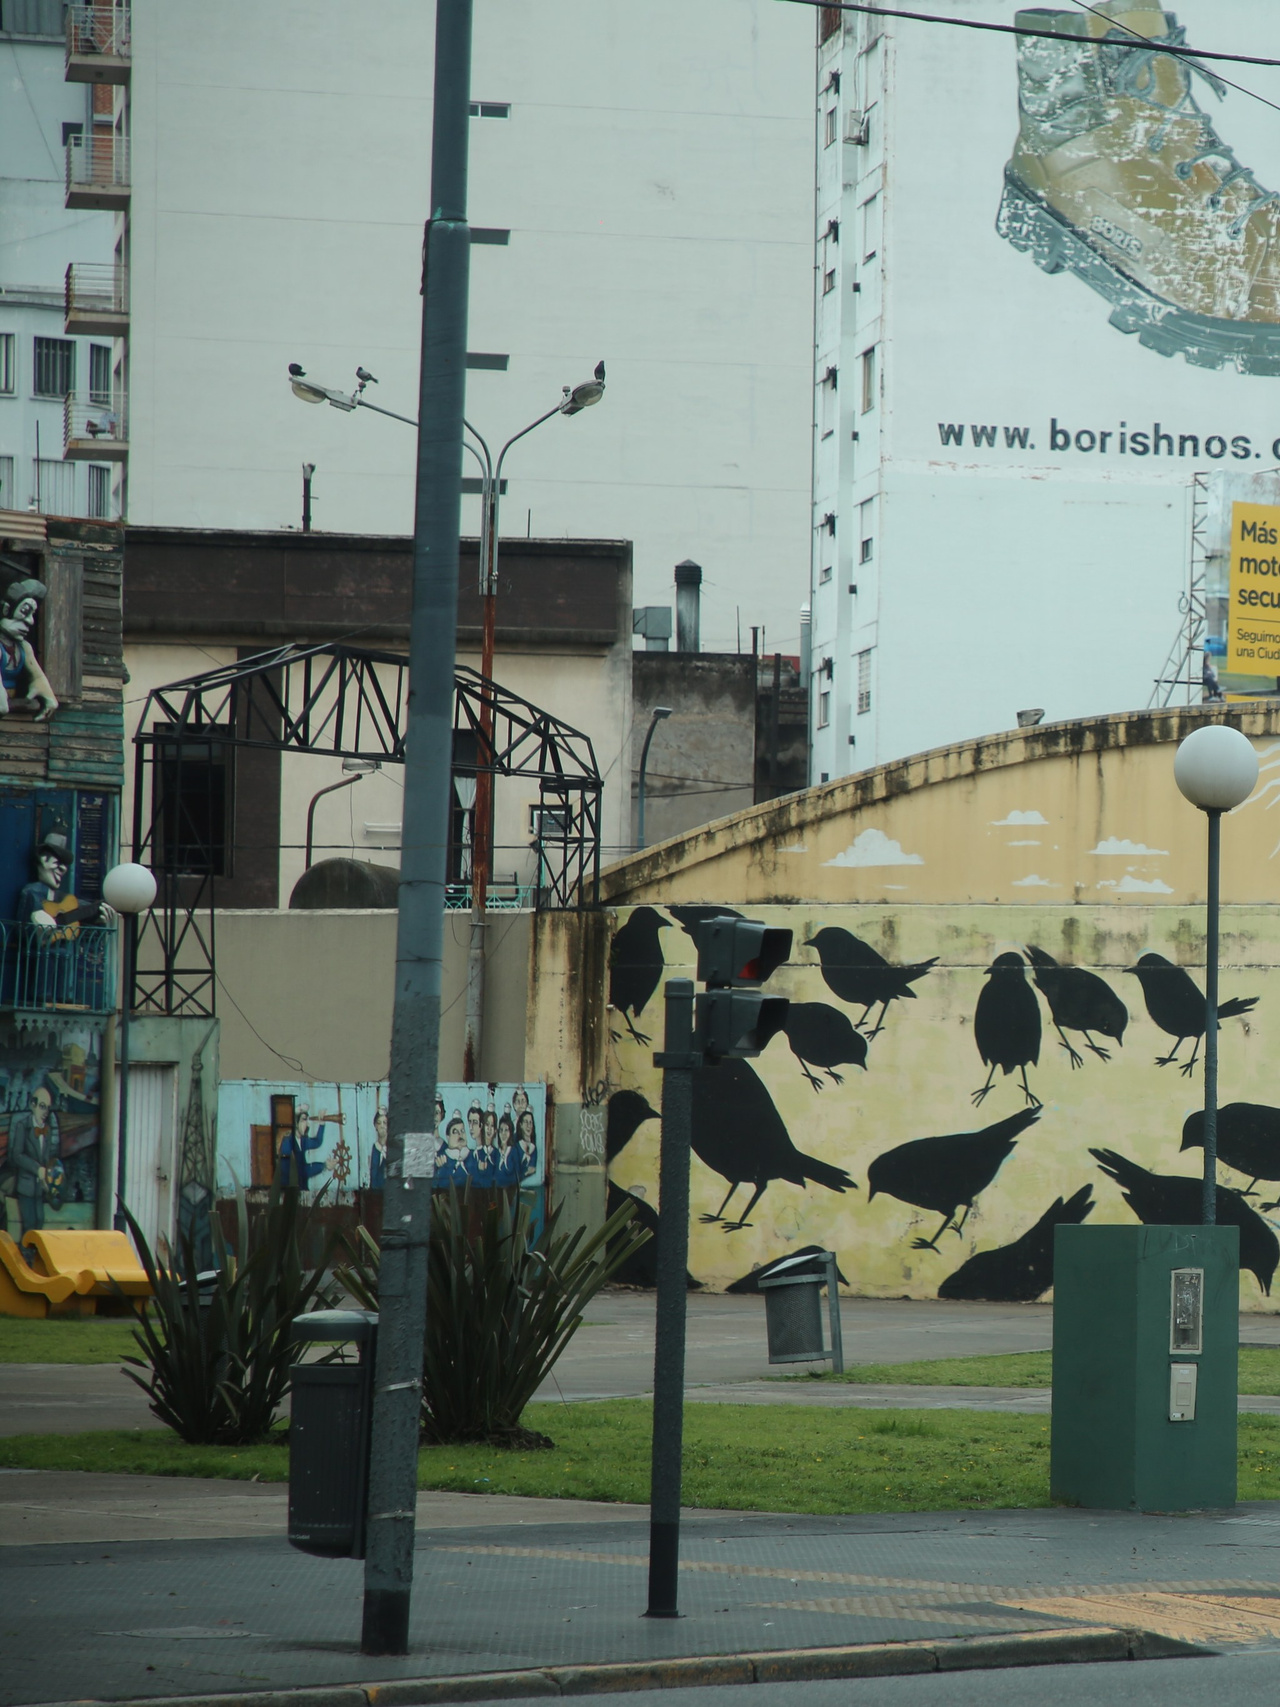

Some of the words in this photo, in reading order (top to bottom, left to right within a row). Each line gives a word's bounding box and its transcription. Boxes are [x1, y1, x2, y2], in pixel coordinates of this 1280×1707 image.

[1090, 215, 1142, 261] BORIS
[1241, 520, 1278, 545] Más
[1236, 647, 1255, 658] una
